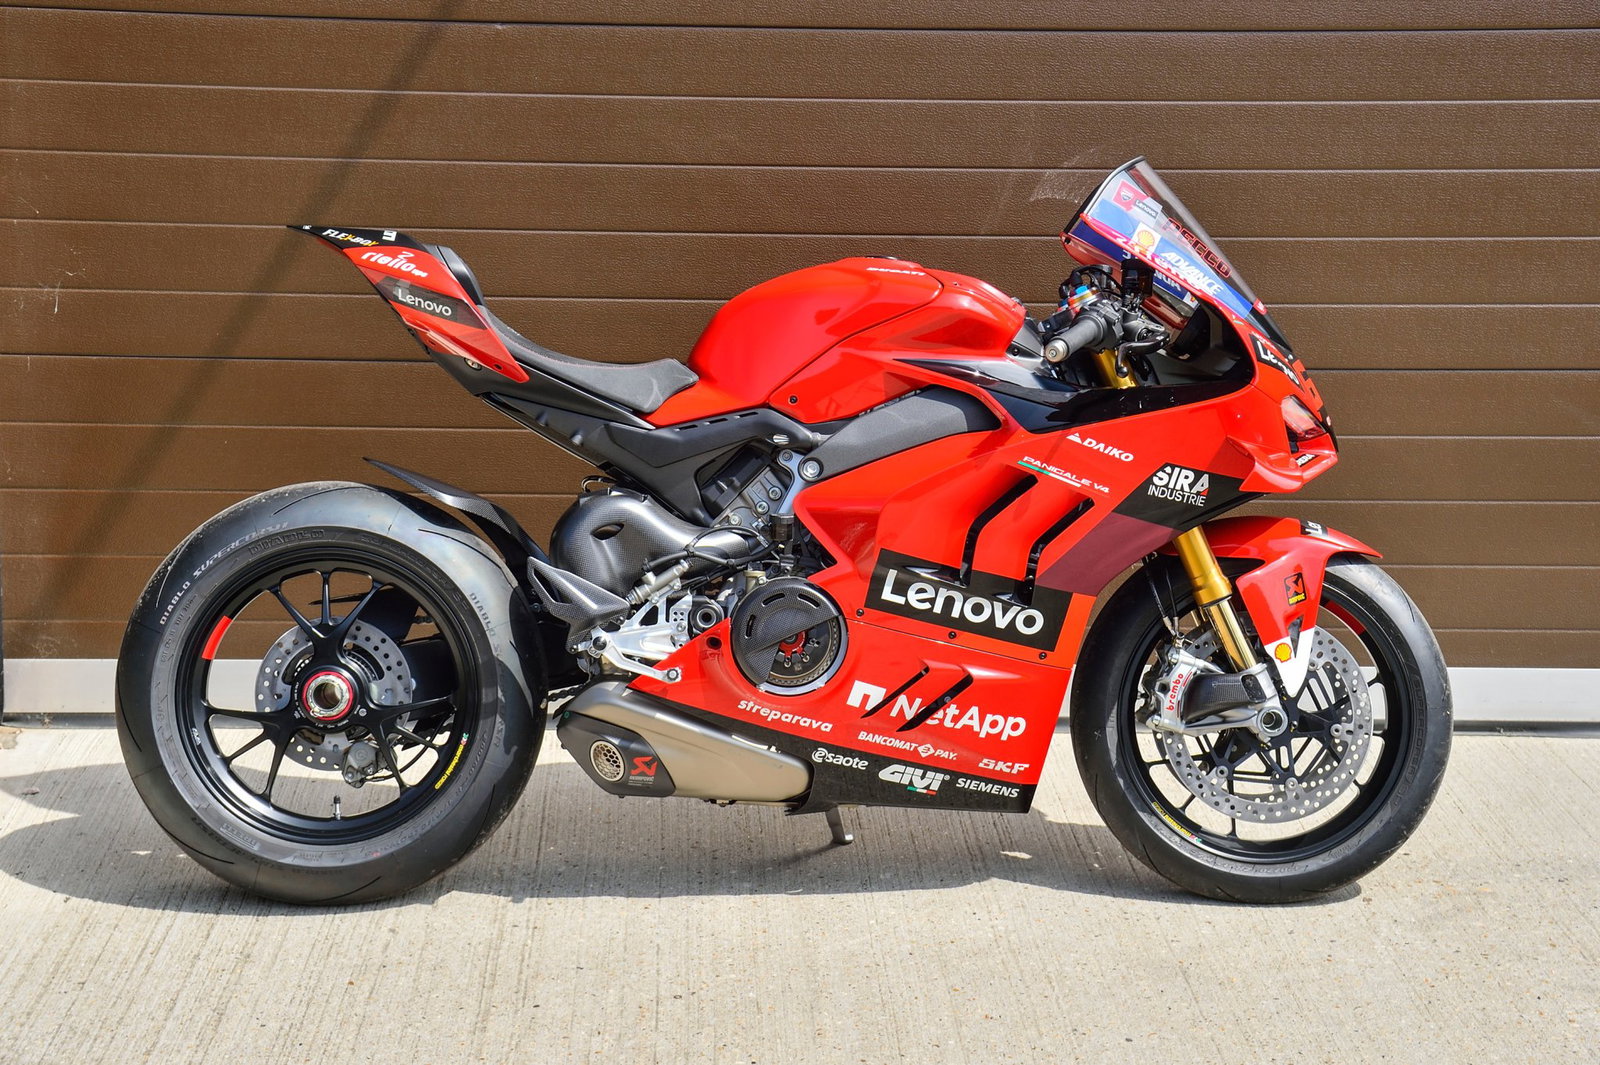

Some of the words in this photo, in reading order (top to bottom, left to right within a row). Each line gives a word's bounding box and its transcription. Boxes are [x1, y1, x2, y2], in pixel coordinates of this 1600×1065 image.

[1160, 252, 1224, 295] ADVANCE
[398, 288, 452, 316] Lenovo
[1082, 437, 1134, 462] DAIKO
[1023, 456, 1092, 487] PANIGALE
[1093, 483, 1110, 493] V4
[1152, 466, 1209, 495] SIRA
[1147, 485, 1207, 507] INDUSTRIE
[160, 580, 190, 626] DIABLO
[880, 568, 1045, 635] Lenovo
[1166, 673, 1184, 711] brembo
[738, 698, 834, 733] streparava
[889, 694, 1026, 741] NetApp
[858, 731, 918, 751] BANCOMAT
[978, 758, 1030, 774] SKF
[956, 778, 1020, 798] SIEMENS
